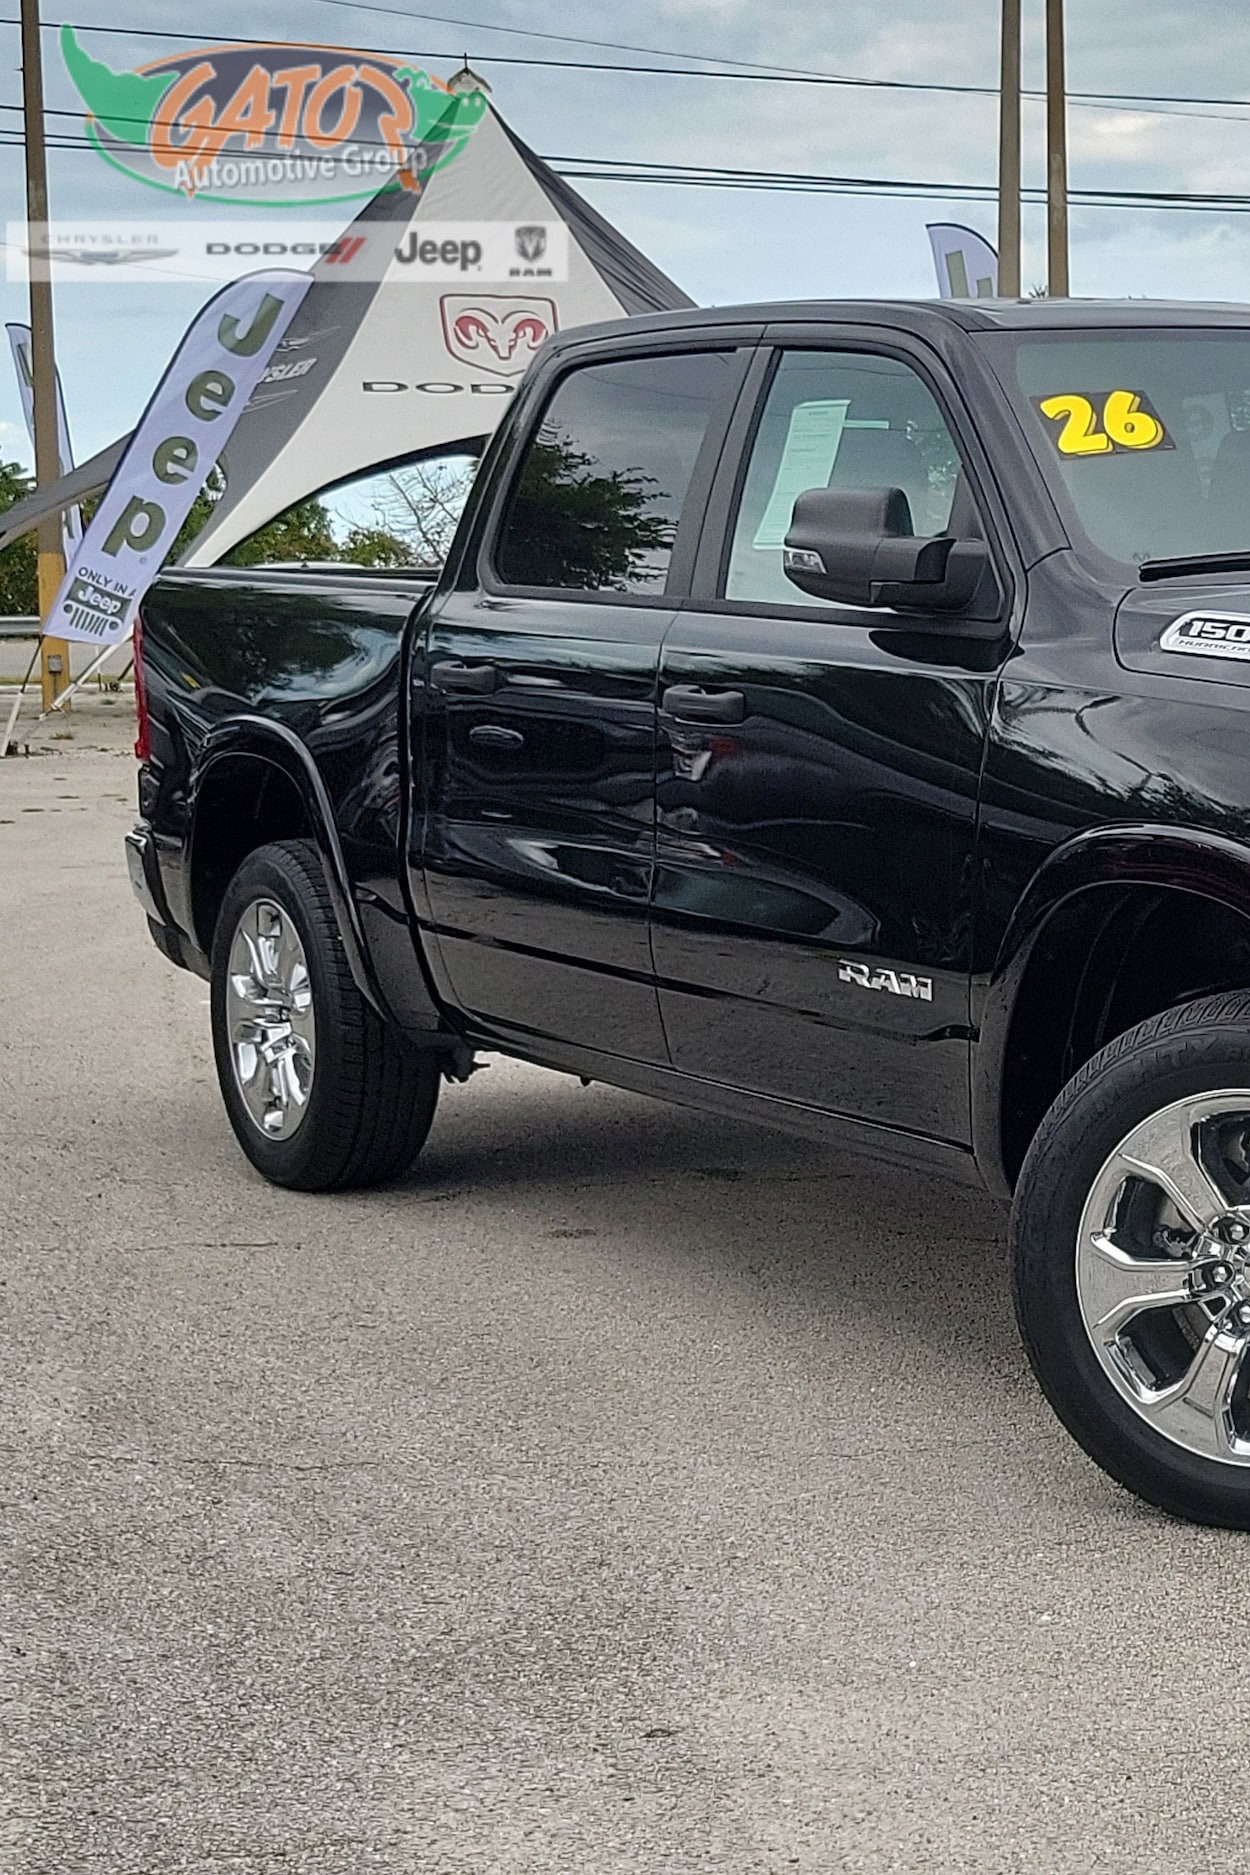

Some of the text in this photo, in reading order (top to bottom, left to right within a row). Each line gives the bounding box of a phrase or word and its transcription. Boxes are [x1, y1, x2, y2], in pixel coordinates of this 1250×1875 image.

[362, 381, 515, 395] DOD
[101, 292, 285, 558] Jeep
[1040, 390, 1164, 456] 26
[78, 566, 112, 588] ONLY
[113, 580, 128, 595] IN
[77, 585, 122, 615] Jeep
[838, 959, 933, 1003] RAM
